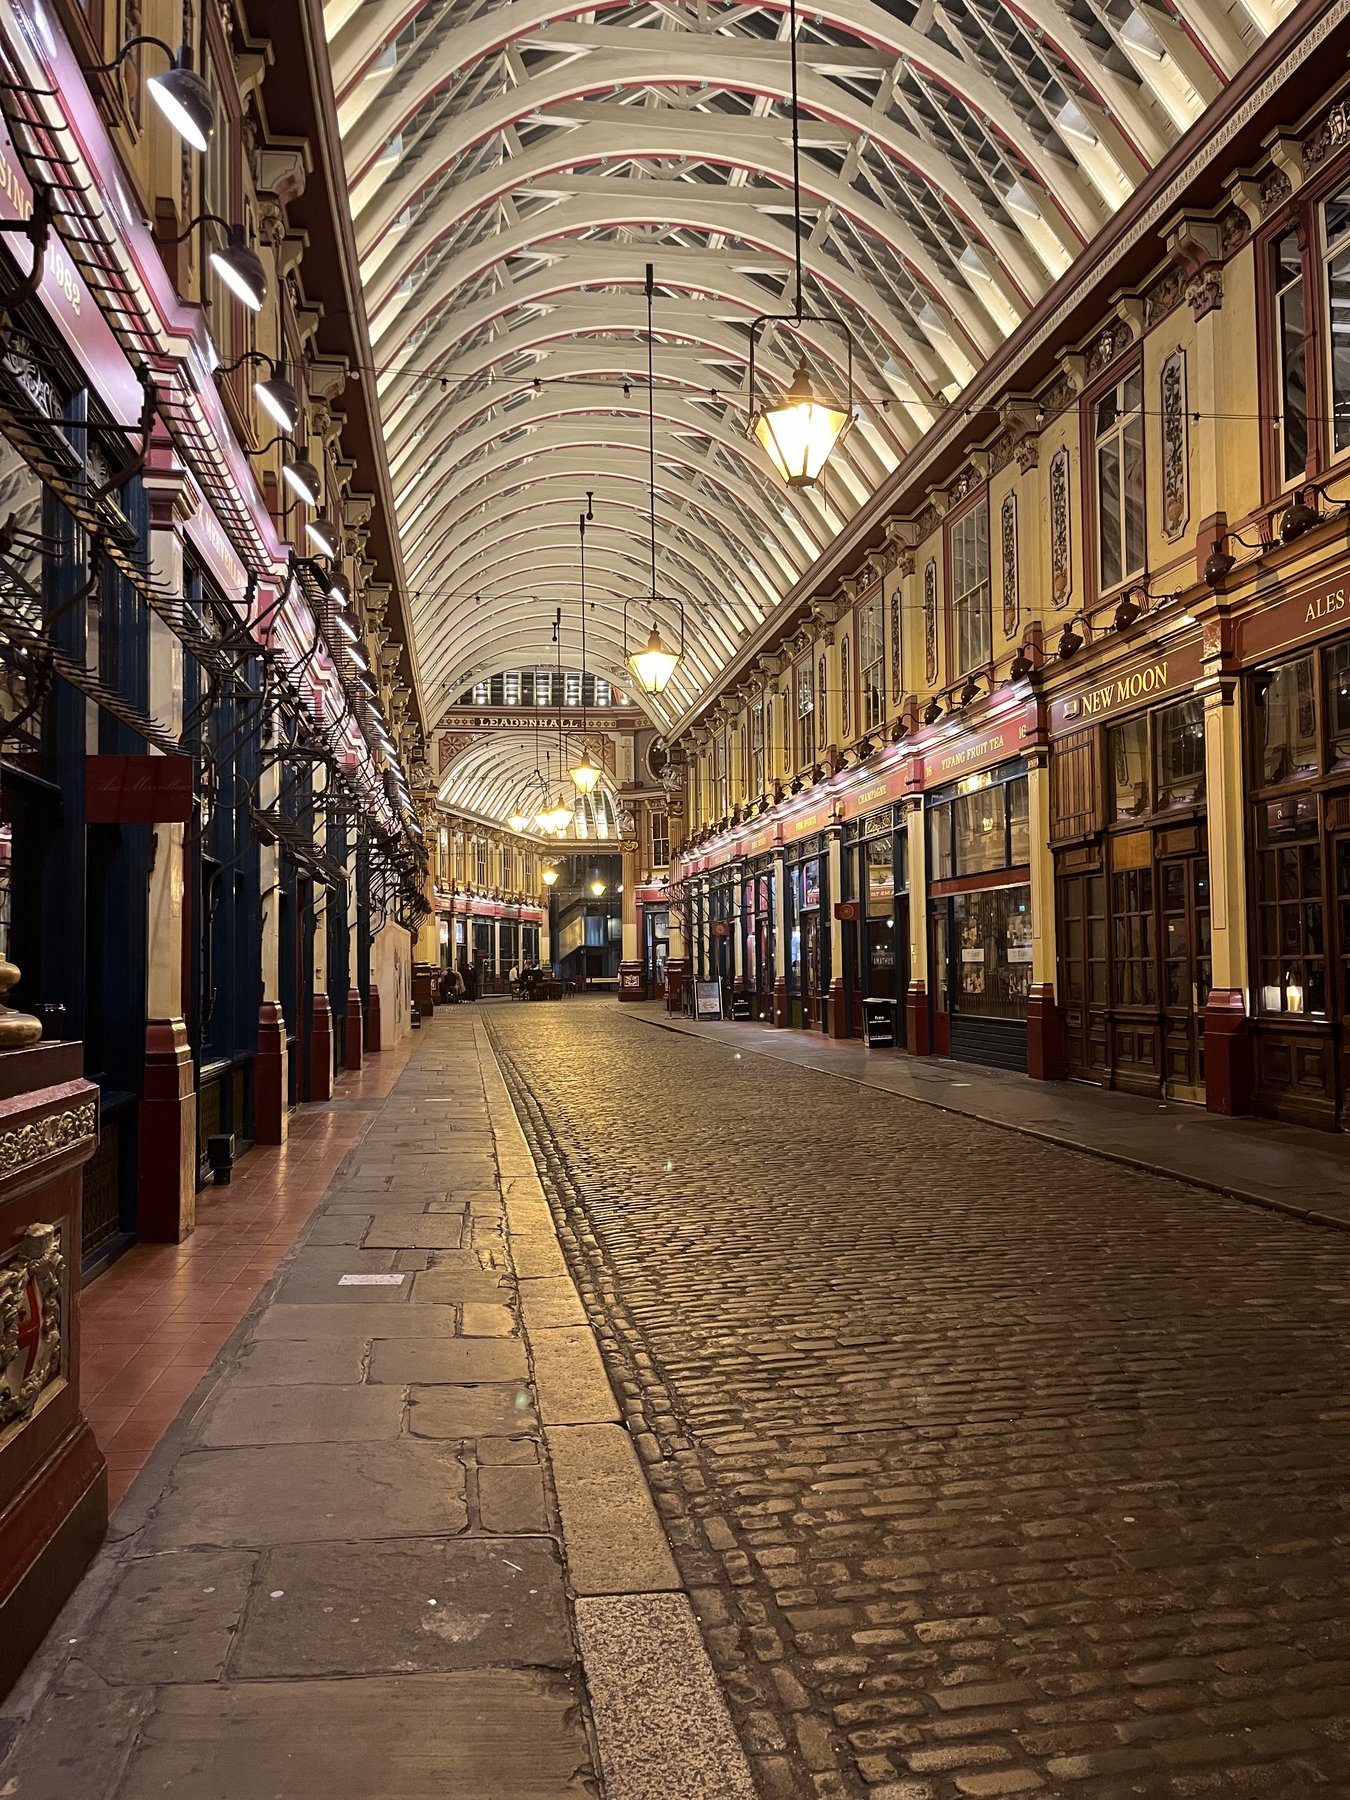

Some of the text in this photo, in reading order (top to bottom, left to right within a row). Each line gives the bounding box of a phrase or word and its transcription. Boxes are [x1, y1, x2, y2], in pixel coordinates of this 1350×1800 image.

[1304, 588, 1345, 622] ALES
[1082, 662, 1168, 717] NEW MOON
[480, 718, 578, 728] LEADENHALL
[941, 734, 1004, 771] YIFANG FRUIT TEA
[858, 784, 887, 805] CHAMPAGNE
[873, 957, 894, 966] AMATHUS
